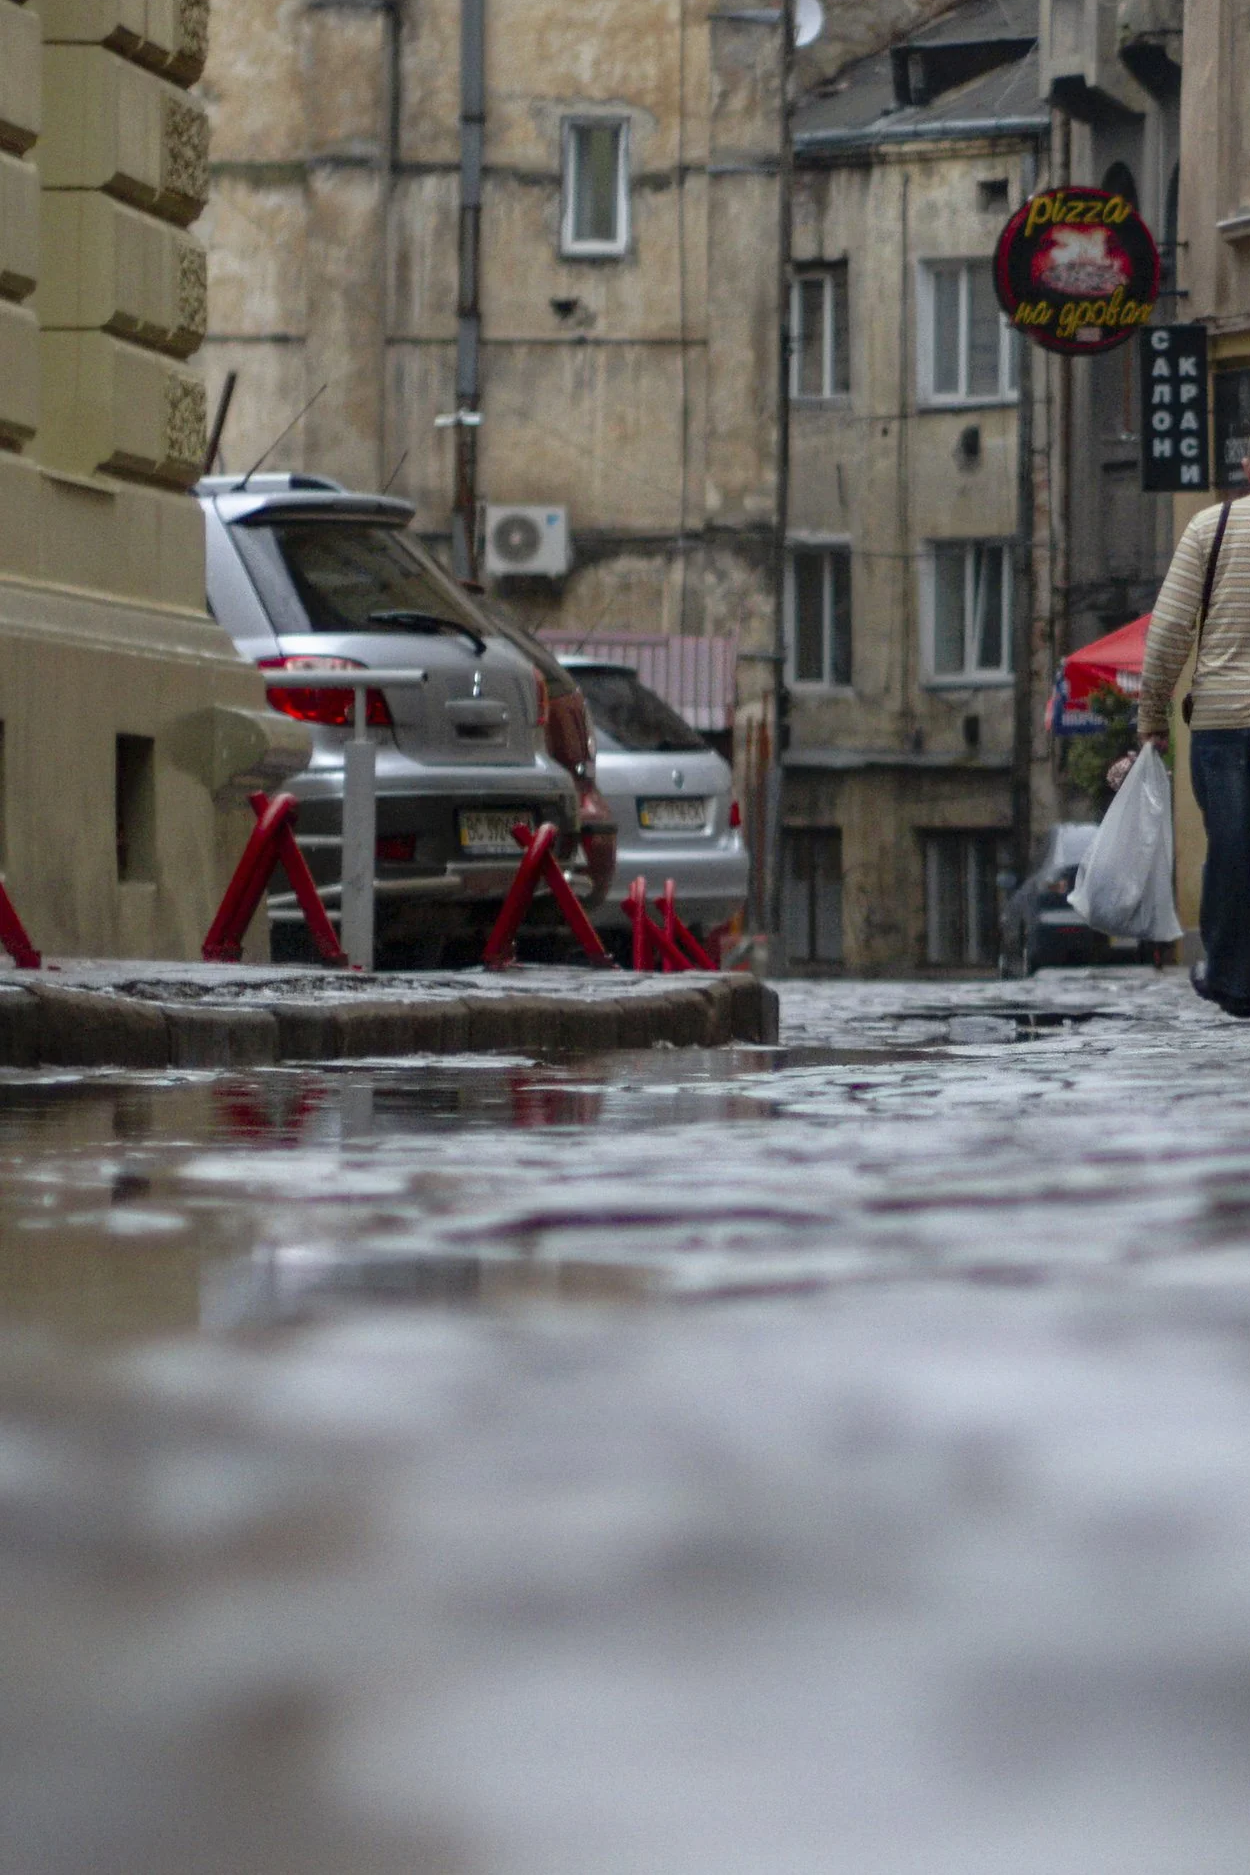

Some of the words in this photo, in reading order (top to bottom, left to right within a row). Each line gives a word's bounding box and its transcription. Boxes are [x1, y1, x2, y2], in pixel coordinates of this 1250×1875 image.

[1025, 193, 1131, 237] pizza
[1015, 301, 1053, 325] на
[1151, 331, 1172, 458] САЛОН
[1179, 356, 1200, 484] КРАСИ
